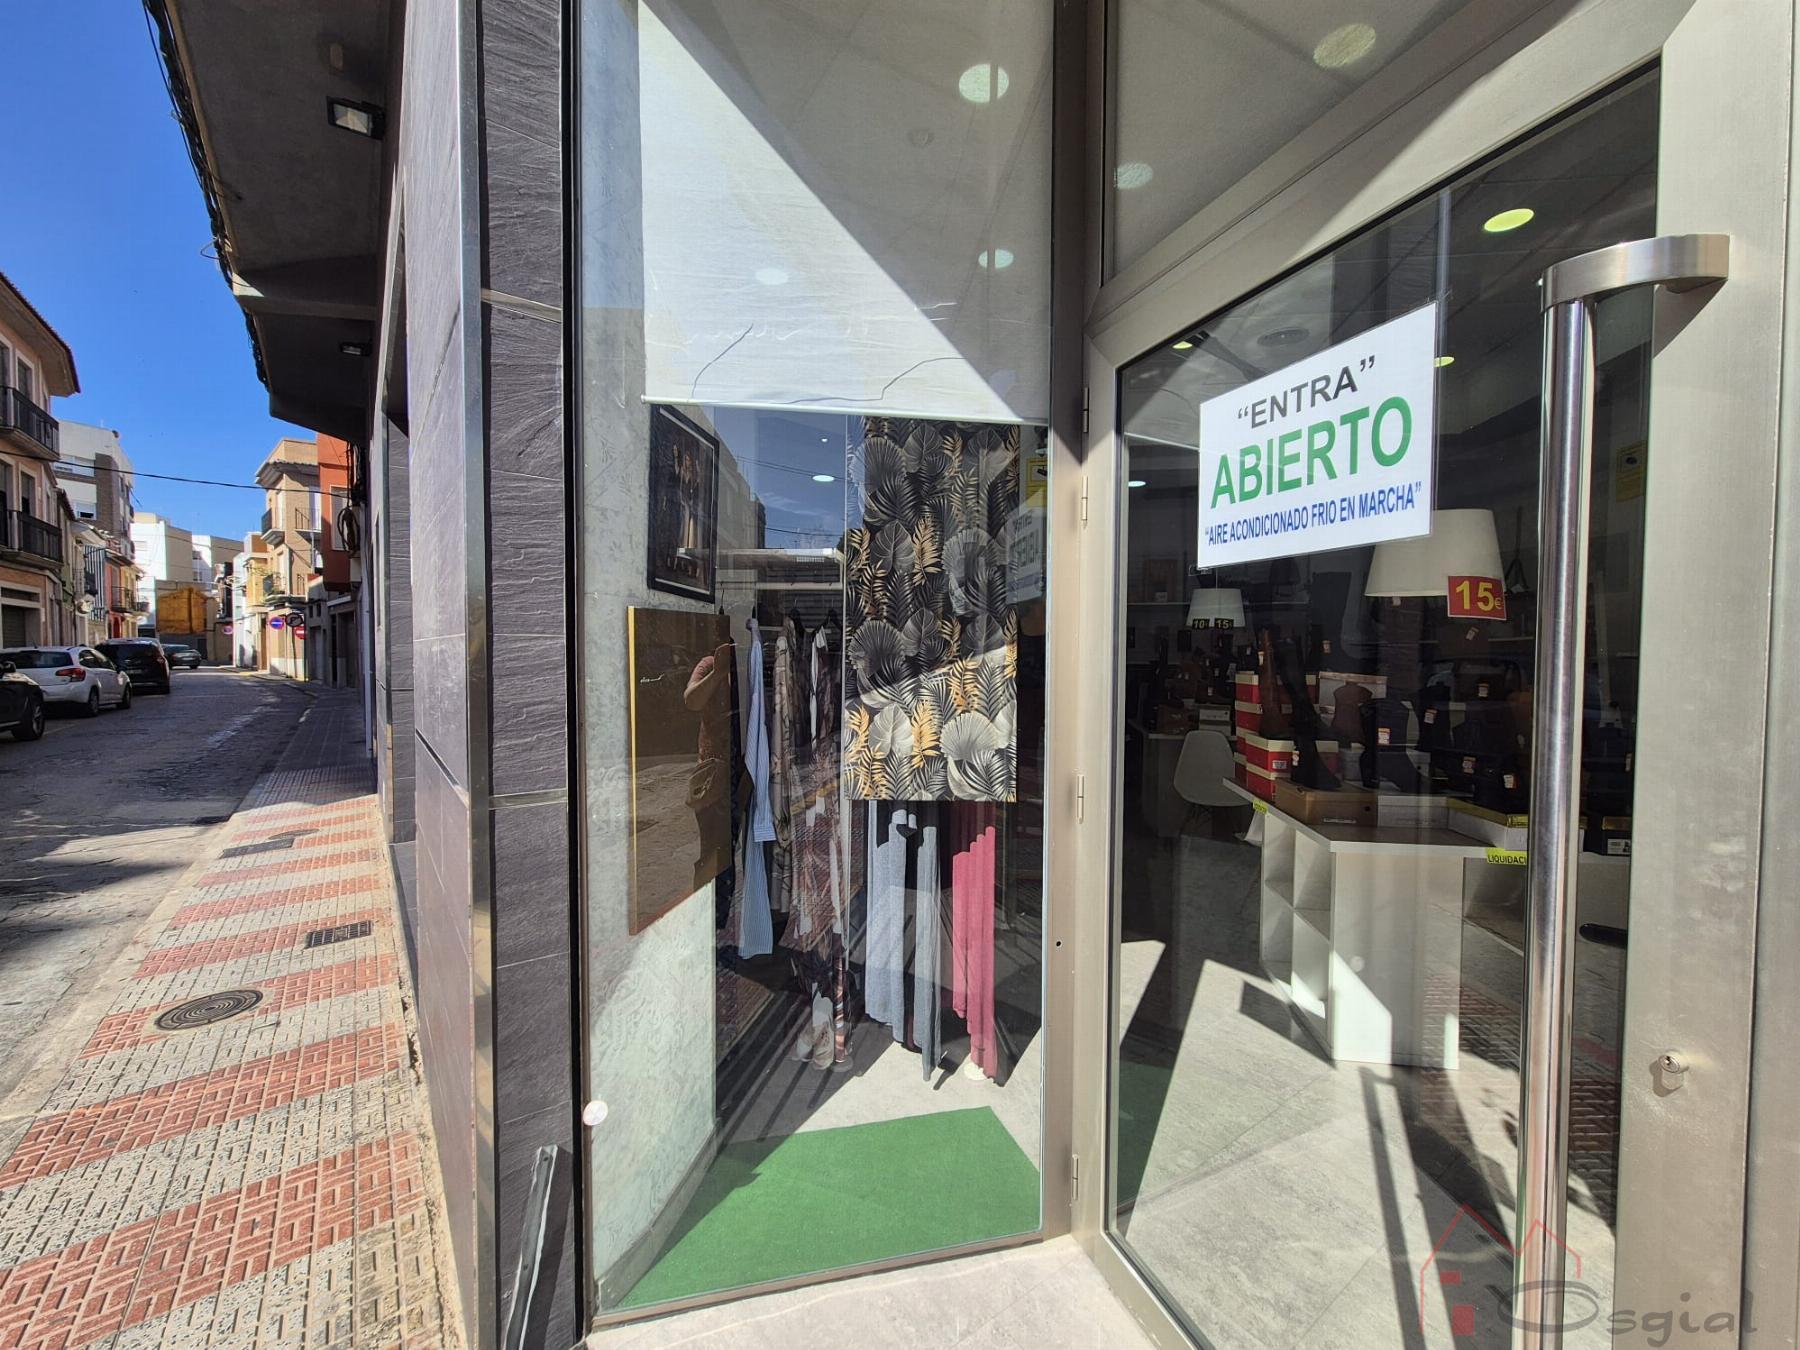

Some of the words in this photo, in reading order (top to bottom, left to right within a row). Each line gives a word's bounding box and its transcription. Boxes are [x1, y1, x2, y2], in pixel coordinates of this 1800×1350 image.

[1210, 395, 1413, 509] ABIERTO
[1229, 506, 1309, 543] ACONDICIONADO
[1311, 499, 1338, 528] FRIO
[1340, 496, 1356, 523] EN
